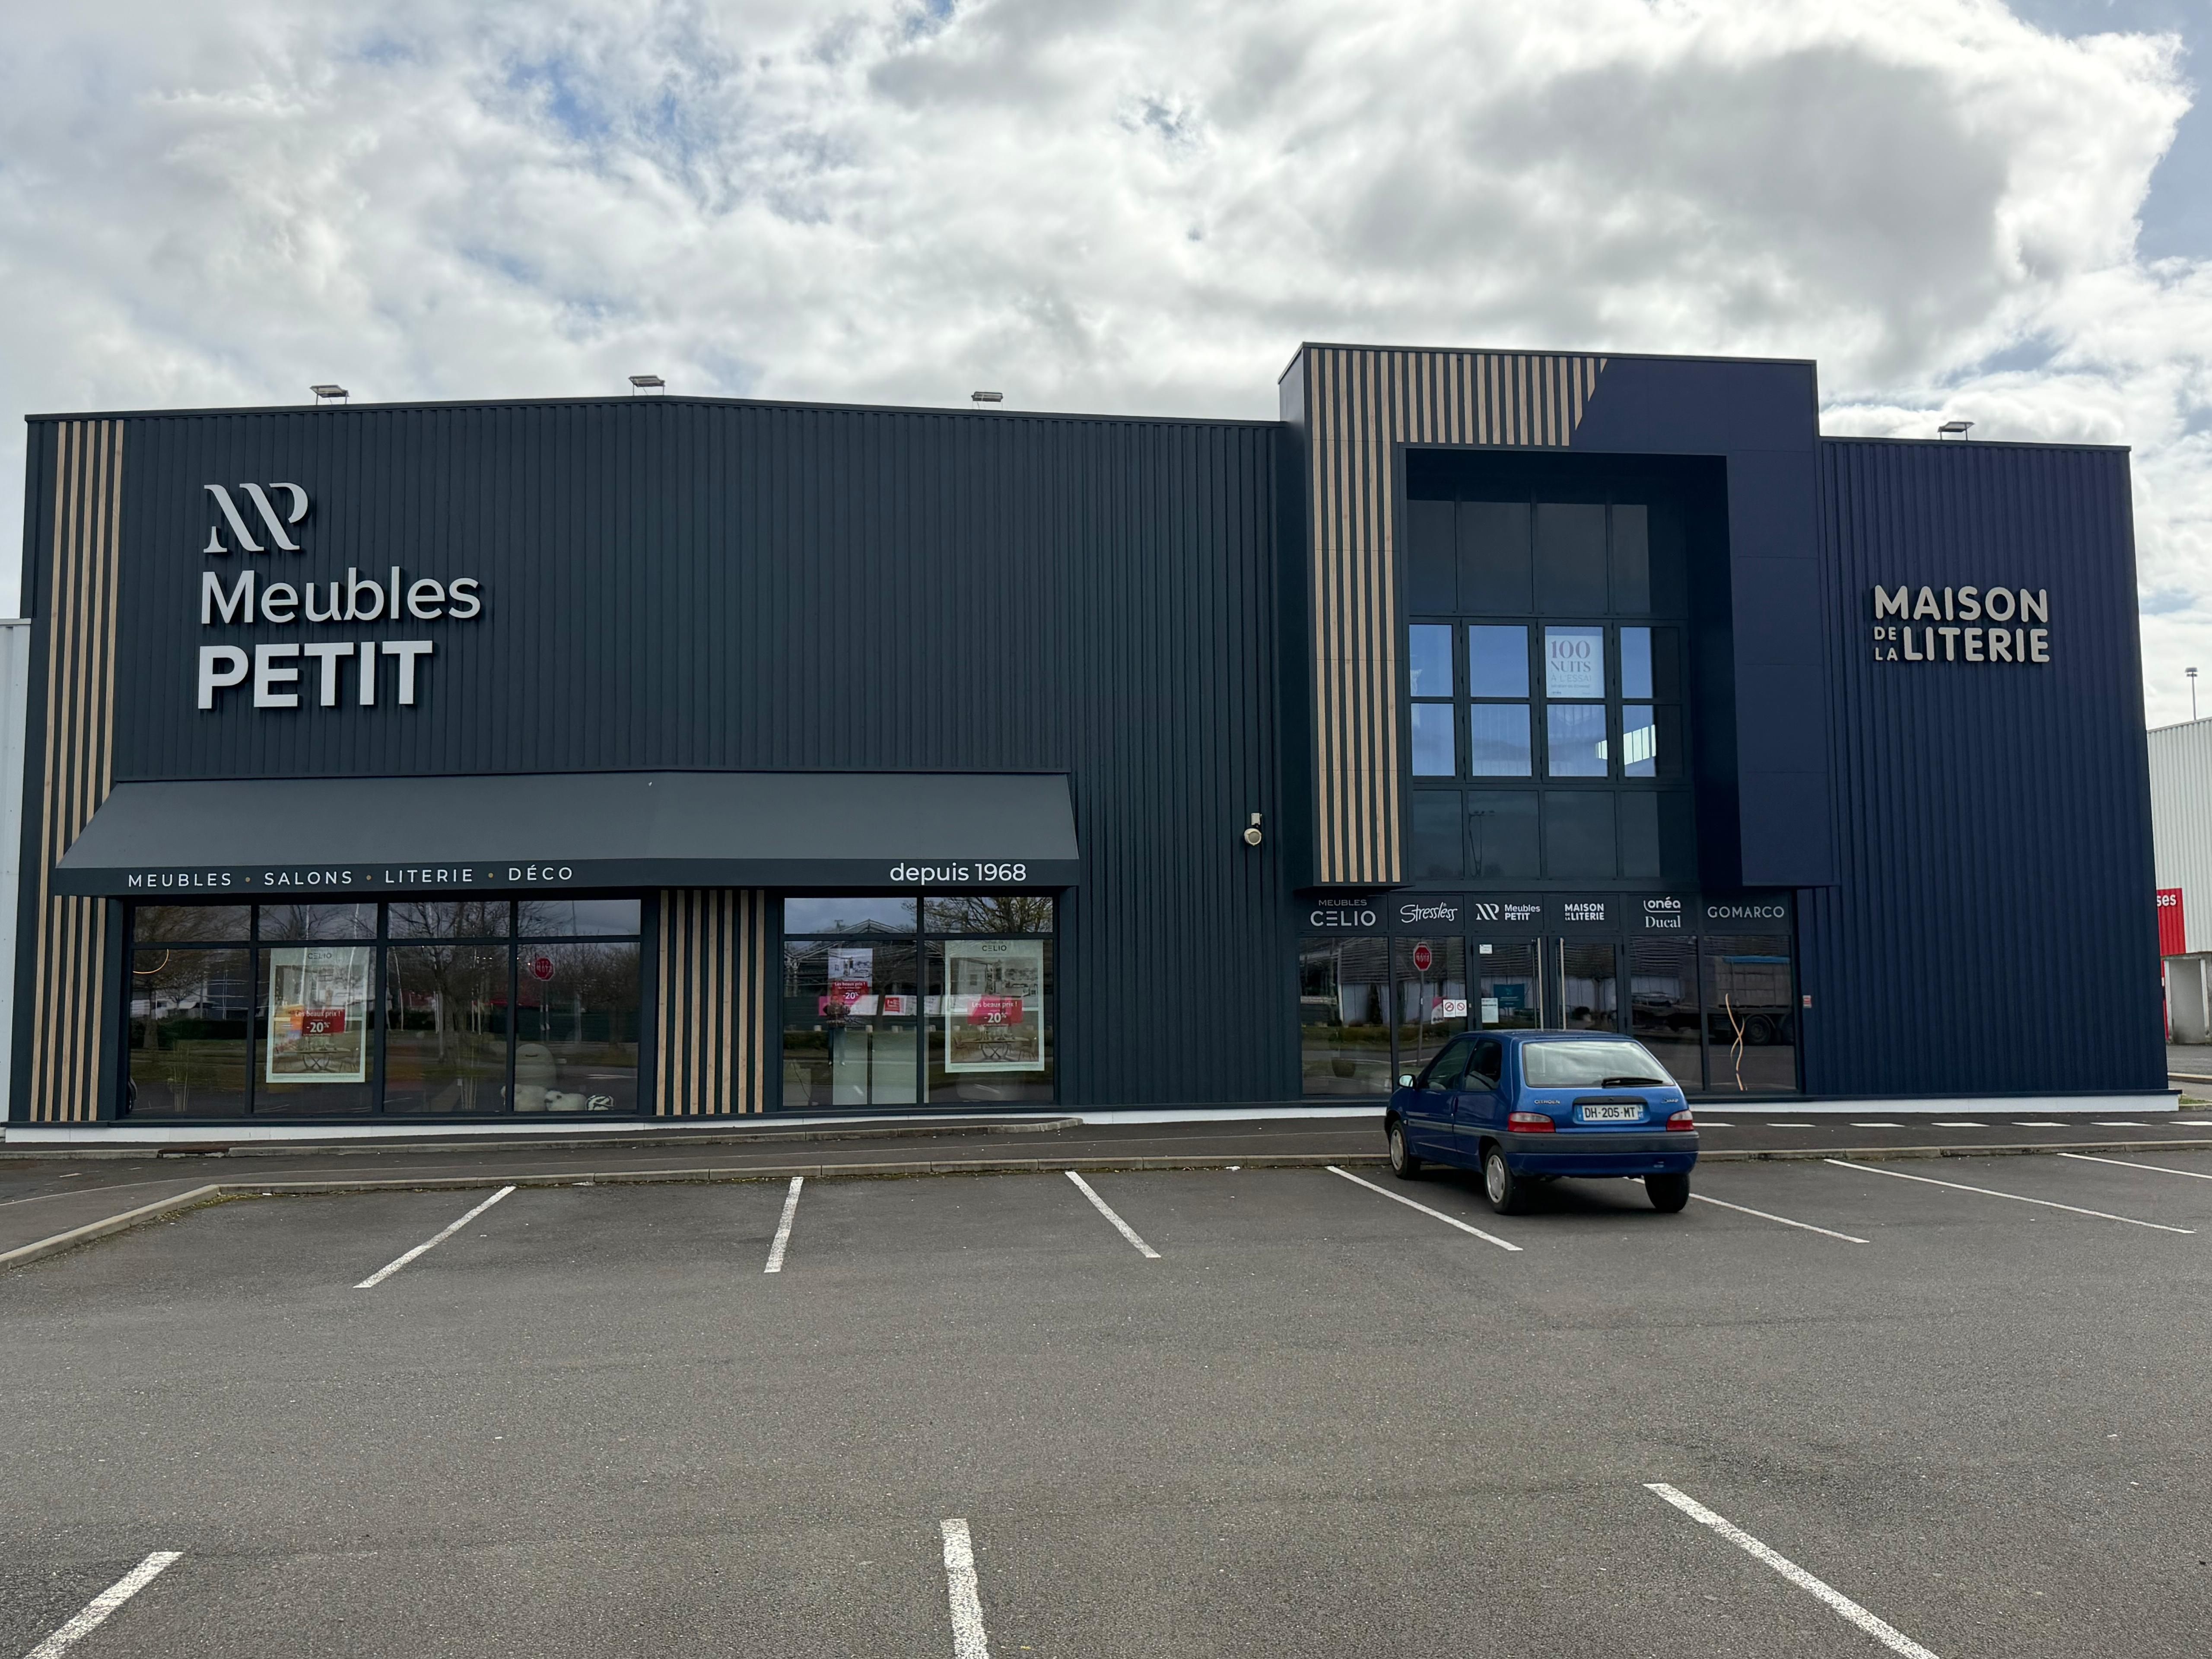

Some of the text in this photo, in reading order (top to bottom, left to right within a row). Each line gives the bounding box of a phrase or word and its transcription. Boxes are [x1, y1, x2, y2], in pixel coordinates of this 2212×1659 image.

[201, 566, 480, 624] Meubles
[1875, 585, 2048, 623] MAISON
[1874, 626, 1896, 640] DE
[1551, 640, 1591, 659] 100
[1904, 626, 2050, 662] LITERIE
[1875, 647, 1898, 661] LA
[1551, 661, 1591, 672] NUITS
[198, 640, 433, 709] PETIT
[129, 864, 572, 887] MEUBLES SALONS LITERIE DÉCO
[890, 862, 1027, 885] depuis 1968
[1400, 902, 1458, 923] Stressless
[1504, 904, 1541, 912] Meubles
[1564, 903, 1604, 912] MAISON
[1707, 906, 1784, 918] GOMARCO
[1310, 911, 1376, 926] CELIO
[1505, 912, 1530, 921] PETIT
[1571, 912, 1605, 921] LITERIE
[1645, 915, 1681, 928] Ducal
[1002, 1001, 1014, 1009] prix
[1584, 1107, 1635, 1118] DH-205-MT
